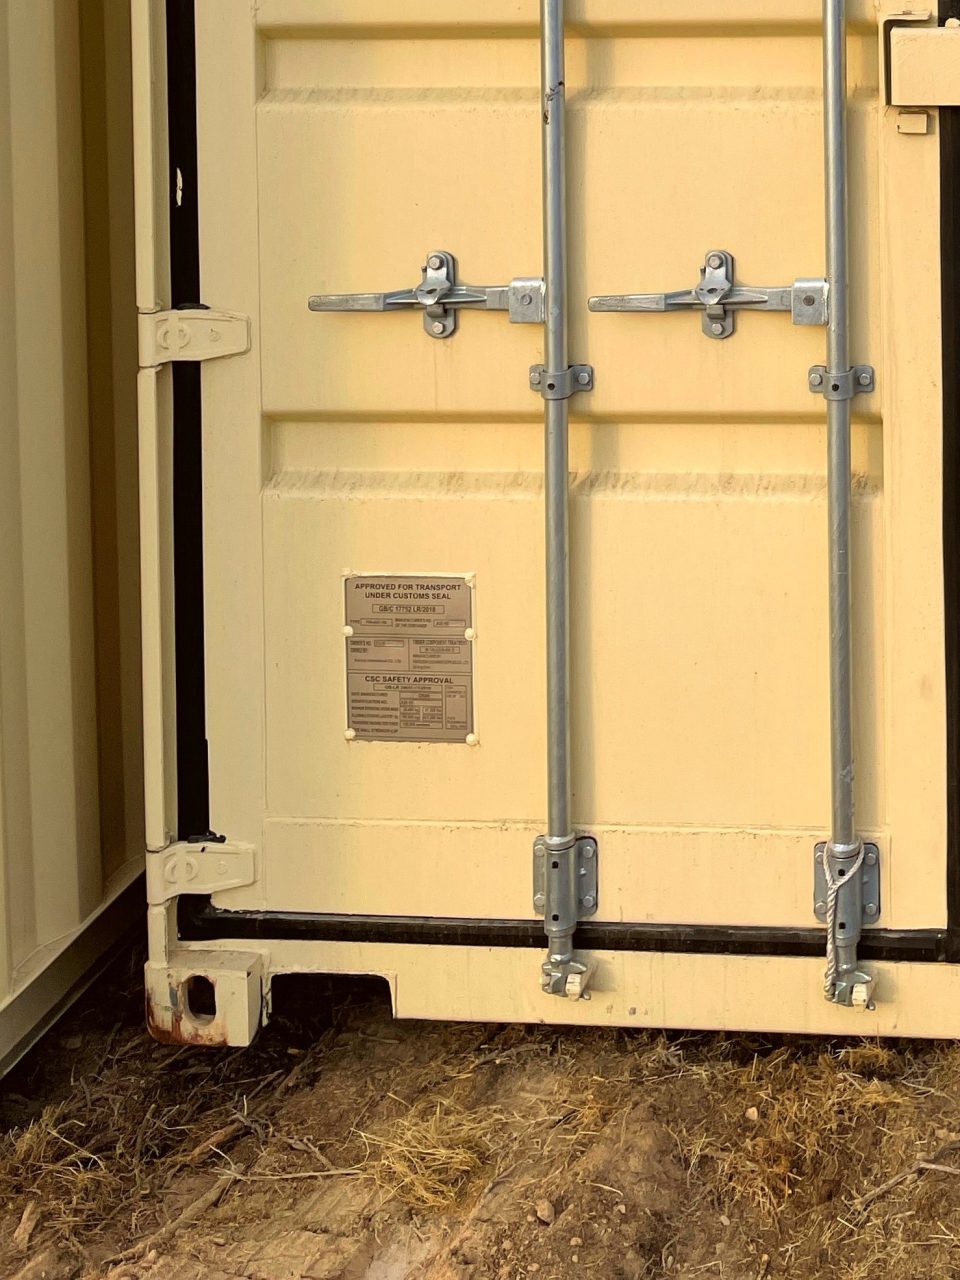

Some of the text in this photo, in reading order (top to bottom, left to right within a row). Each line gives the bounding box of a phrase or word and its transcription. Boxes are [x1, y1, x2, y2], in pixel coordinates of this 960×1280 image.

[355, 583, 396, 591] APPROVED
[382, 675, 411, 683] SAFETY
[413, 676, 454, 684] APPROVAL
